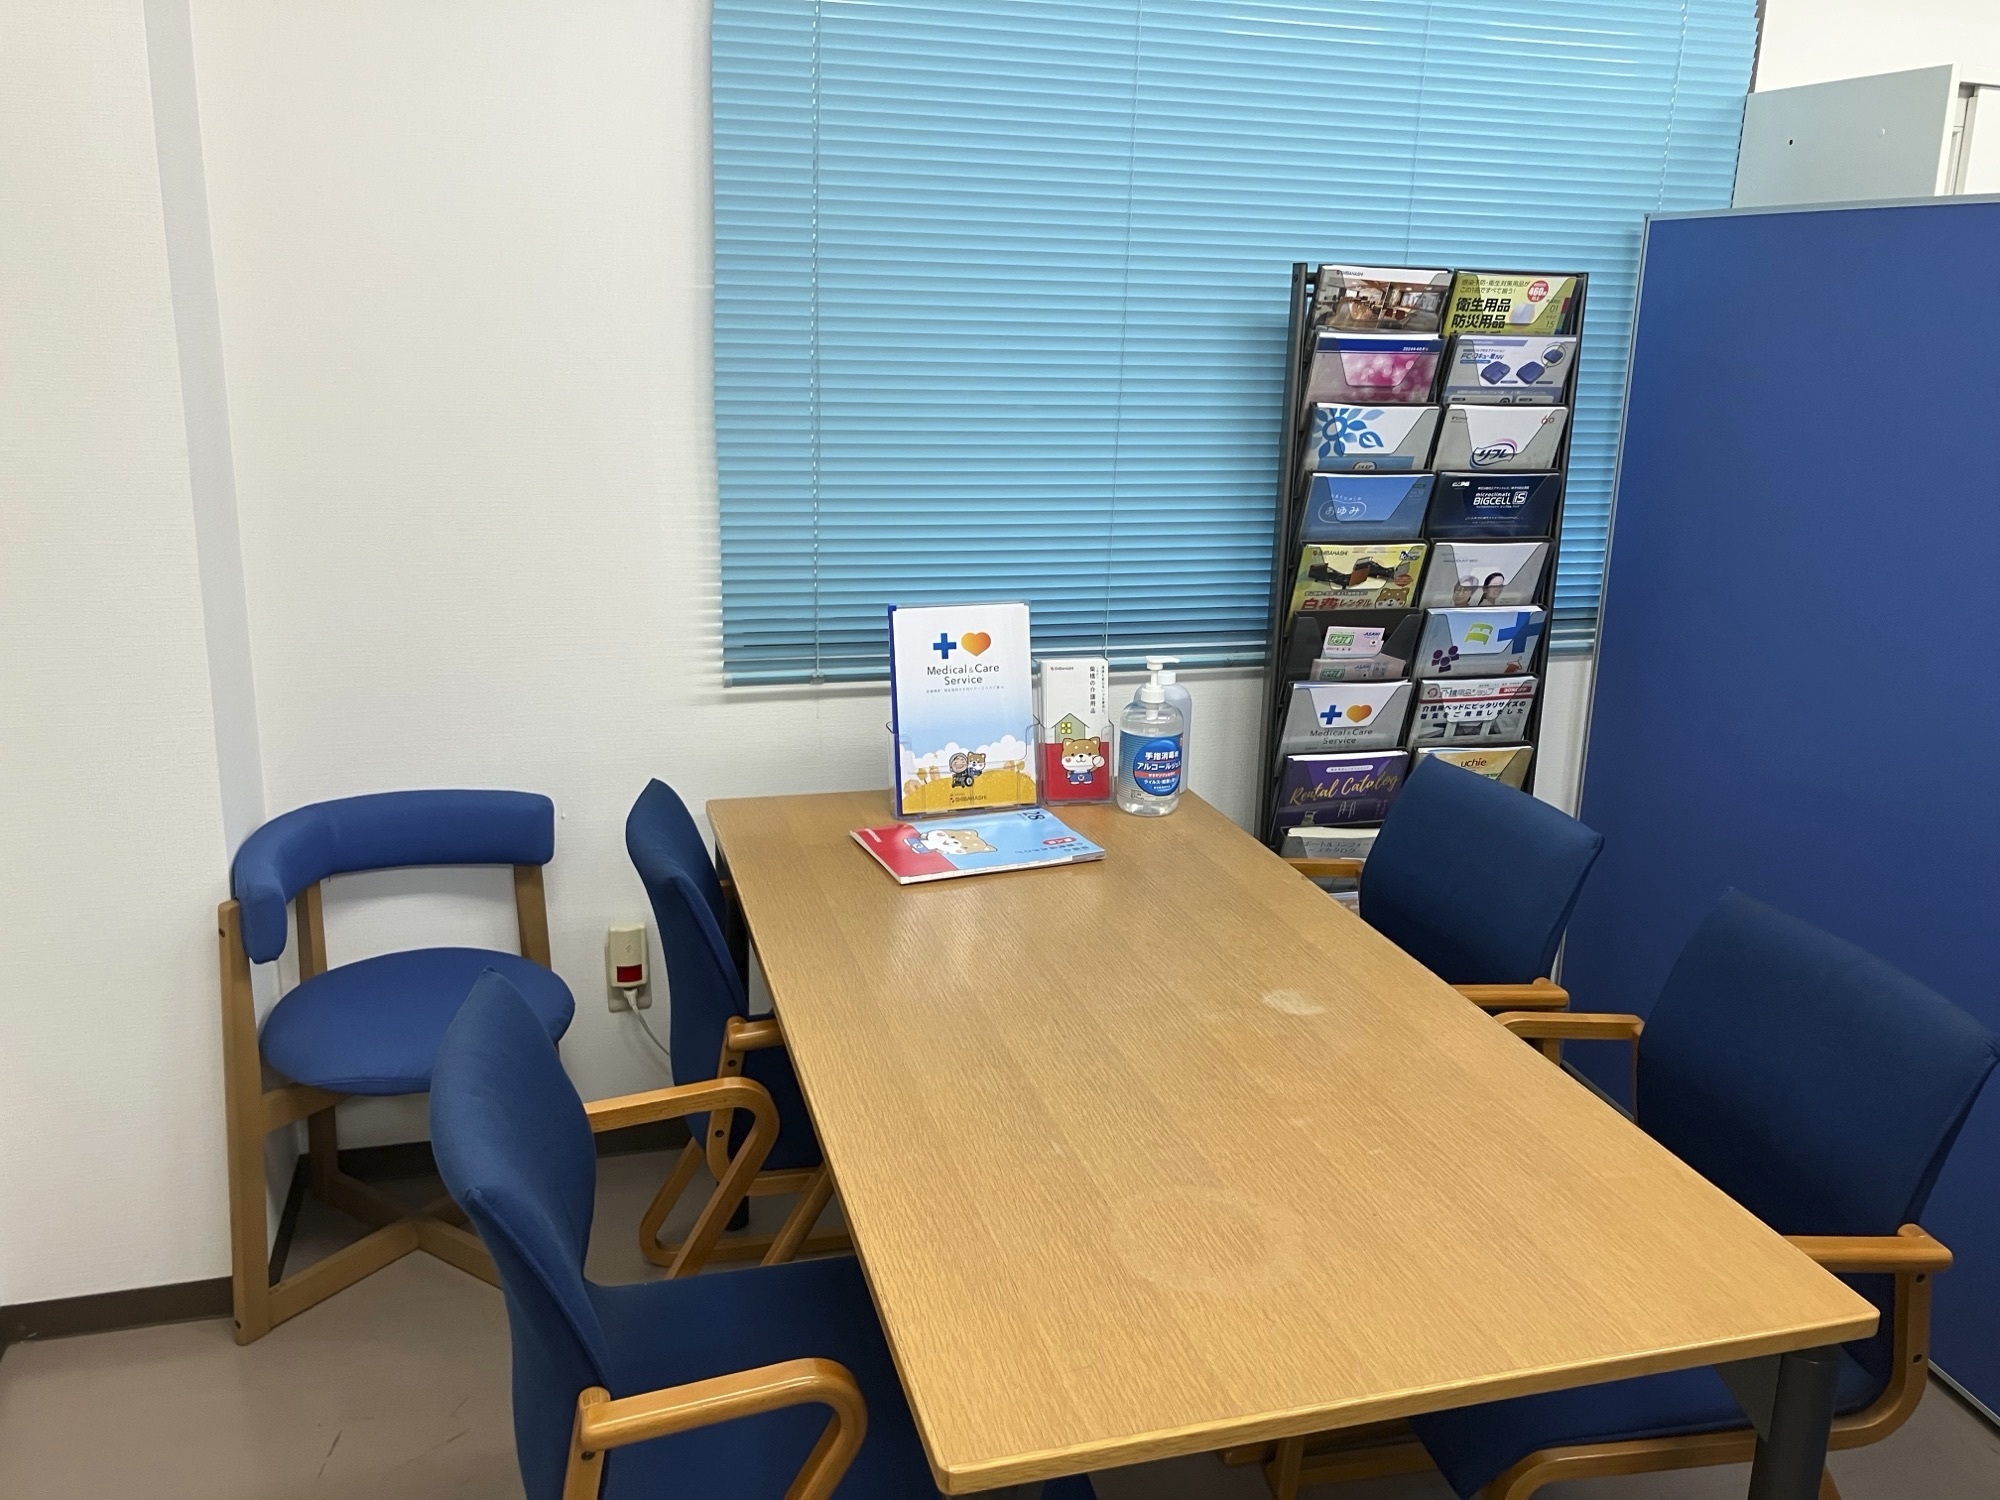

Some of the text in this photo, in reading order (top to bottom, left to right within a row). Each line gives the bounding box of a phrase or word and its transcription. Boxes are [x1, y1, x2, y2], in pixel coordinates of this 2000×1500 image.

[1456, 298, 1512, 313] 衛生用品
[1451, 314, 1506, 329] 防災用品
[1473, 497, 1511, 505] BIGCELL
[1325, 506, 1360, 516] あゆみ
[927, 664, 967, 676] Medical
[974, 663, 1000, 673] Care
[944, 675, 983, 686] Service
[1310, 728, 1346, 737] Medical
[1352, 728, 1373, 736] Care
[1460, 757, 1487, 768] uchie
[1290, 770, 1399, 806] Rental Catalog
